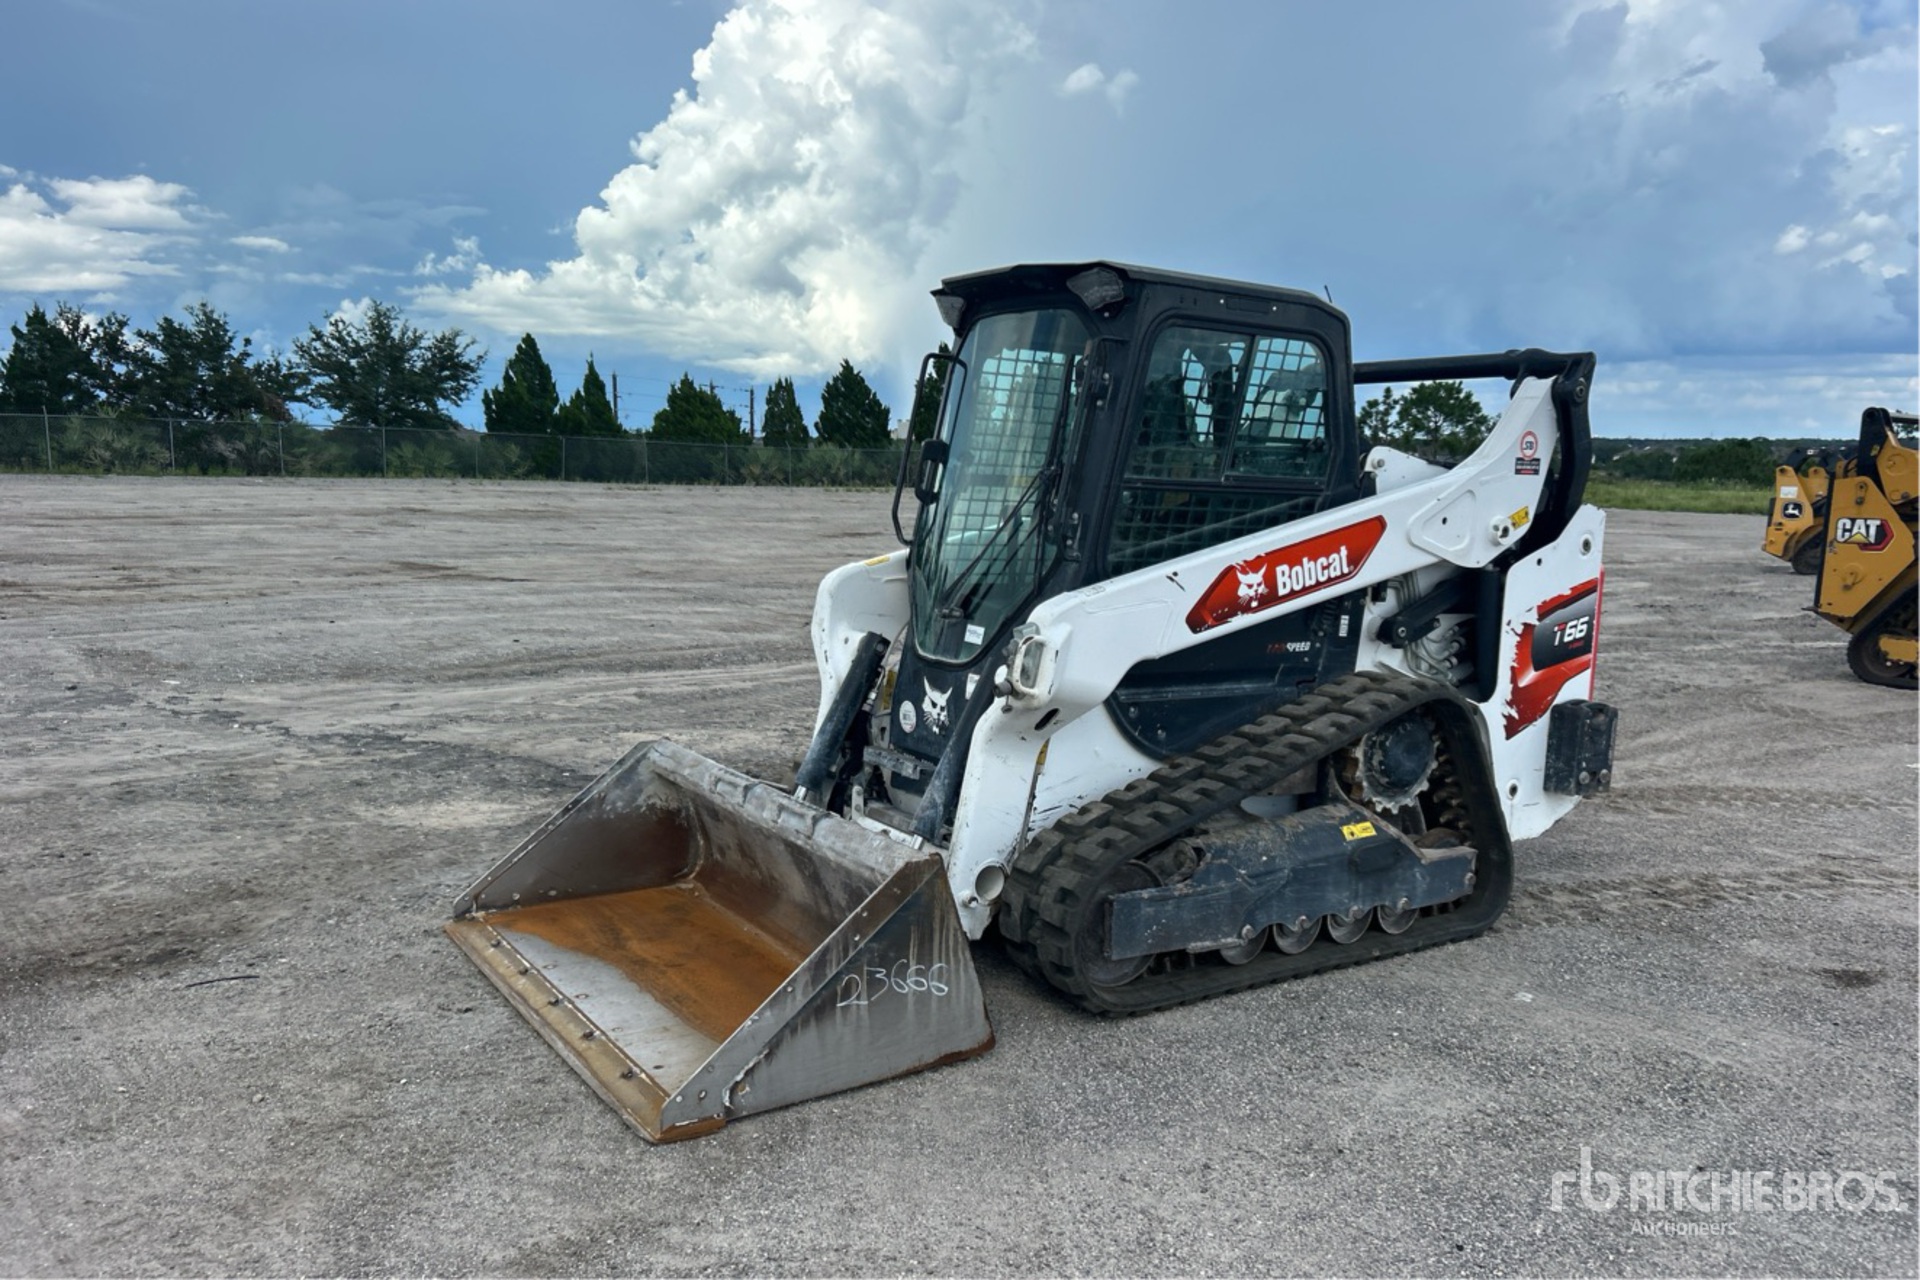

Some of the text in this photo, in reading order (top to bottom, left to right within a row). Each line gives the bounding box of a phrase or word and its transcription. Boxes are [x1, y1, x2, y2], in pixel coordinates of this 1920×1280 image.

[1836, 518, 1881, 543] CAT
[1275, 545, 1349, 597] Bobcat
[1553, 616, 1590, 647] T66
[836, 959, 949, 1007] 23666
